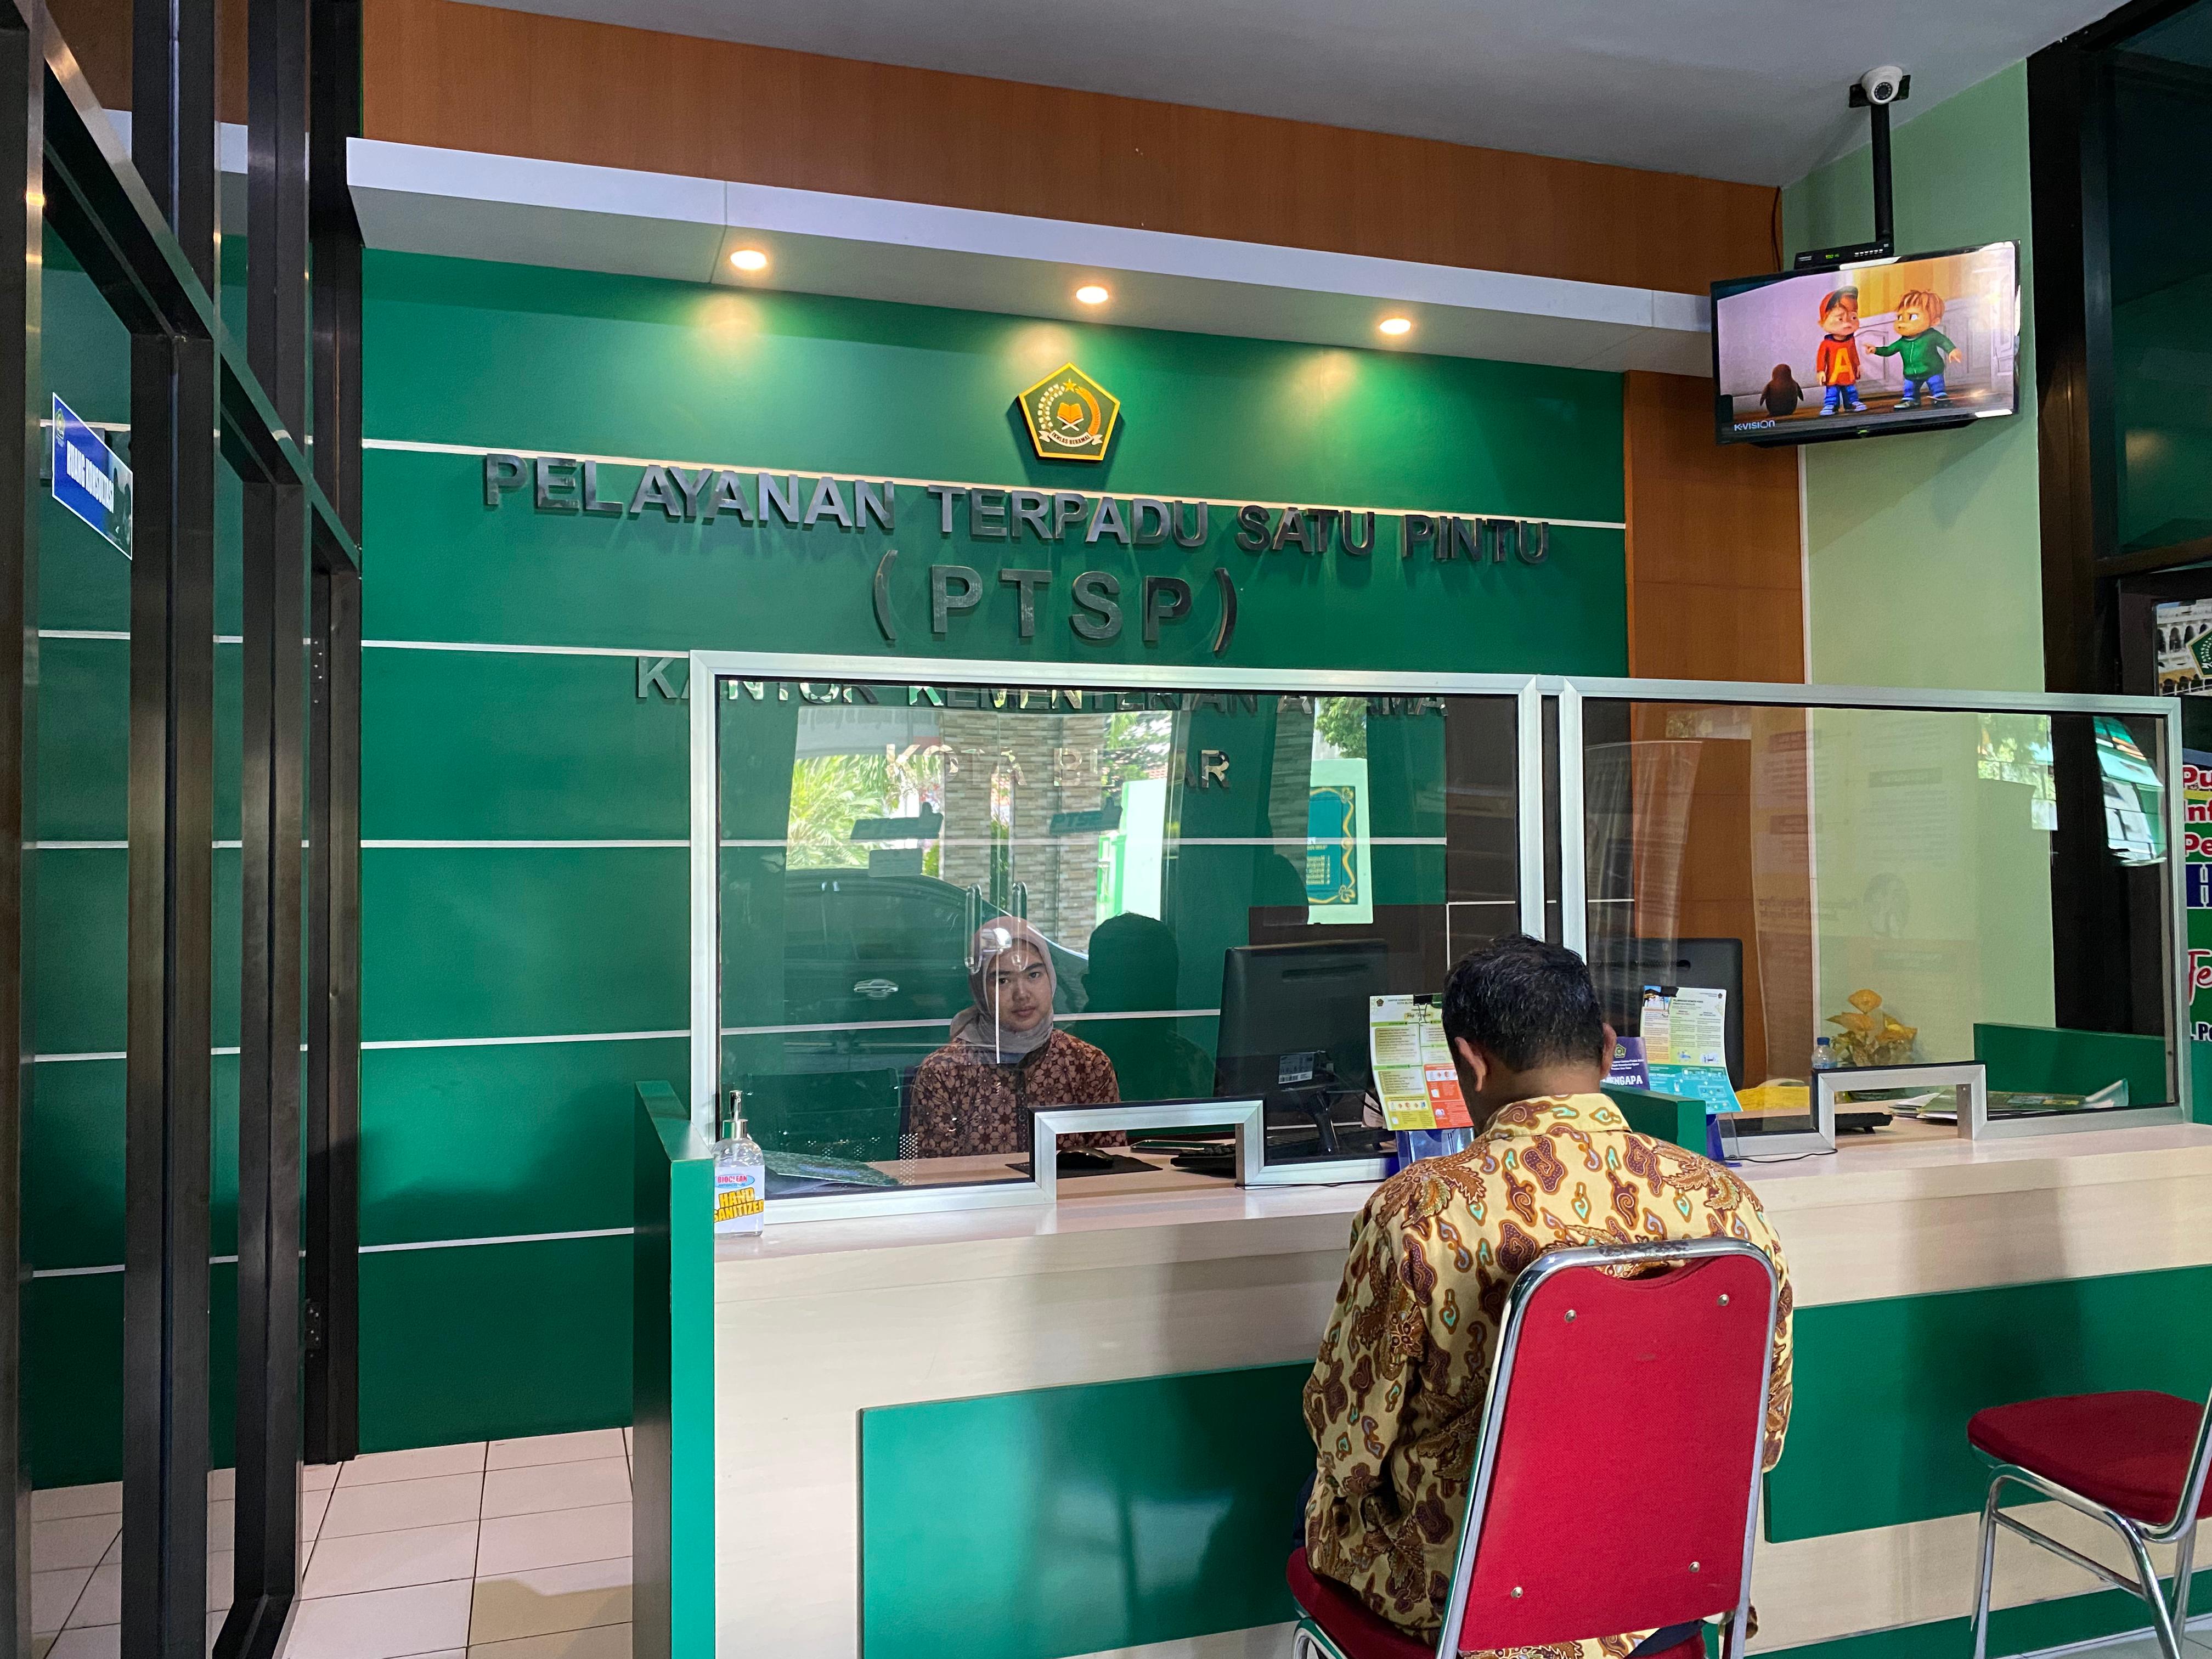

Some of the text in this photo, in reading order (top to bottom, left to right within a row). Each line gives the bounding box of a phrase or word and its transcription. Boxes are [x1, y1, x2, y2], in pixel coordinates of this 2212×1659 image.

[1052, 432, 1091, 445] IKHLAS BERAMAL
[484, 453, 1550, 565] PELAYANAN TERPADU SATU PINTU
[637, 656, 880, 704] KNOR
[719, 1187, 755, 1208] HAND
[714, 1199, 764, 1223] SANITIZER
